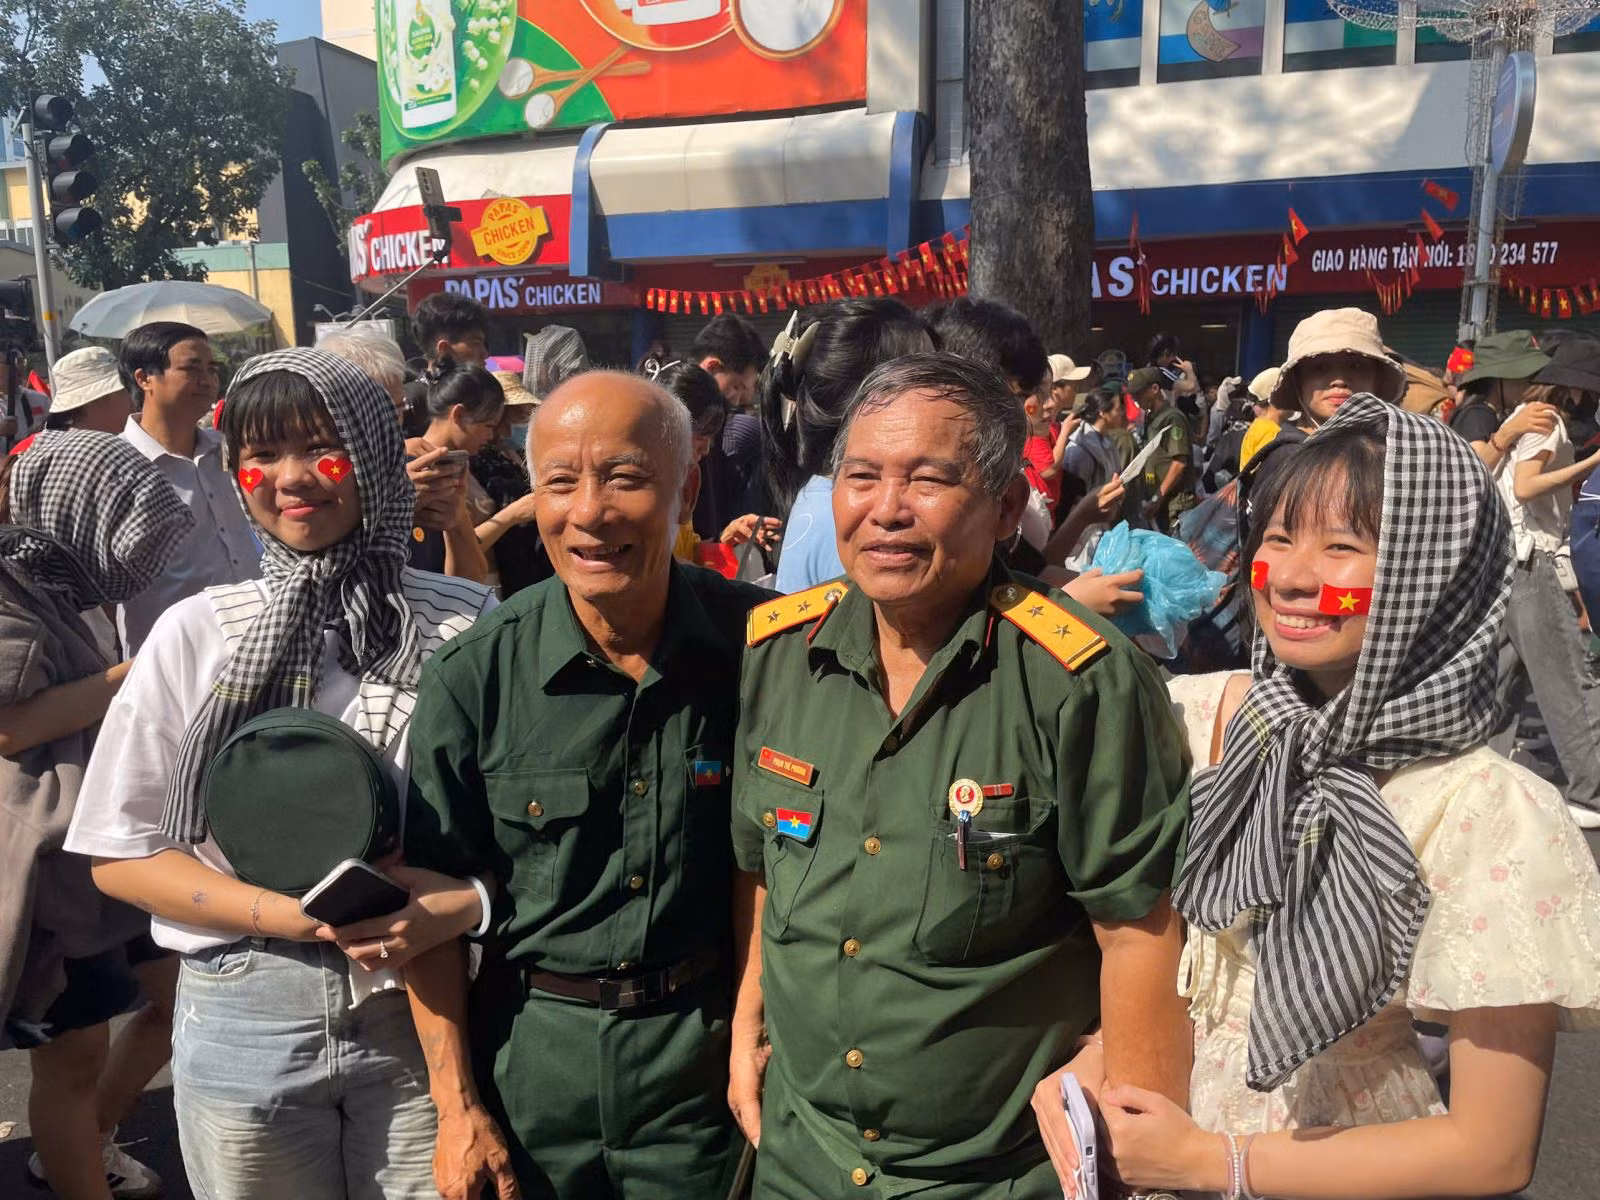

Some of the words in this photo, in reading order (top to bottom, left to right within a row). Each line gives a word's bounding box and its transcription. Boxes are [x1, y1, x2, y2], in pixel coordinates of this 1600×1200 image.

[483, 216, 535, 246] CHICKEN
[1311, 248, 1345, 272] GIAO
[1348, 244, 1388, 271] HÀNG
[1391, 241, 1419, 273] TẬN
[1500, 242, 1526, 266] 234
[1532, 241, 1558, 265] 577
[524, 283, 601, 307] CHICKEN
[1151, 263, 1287, 296] CHICKEN
